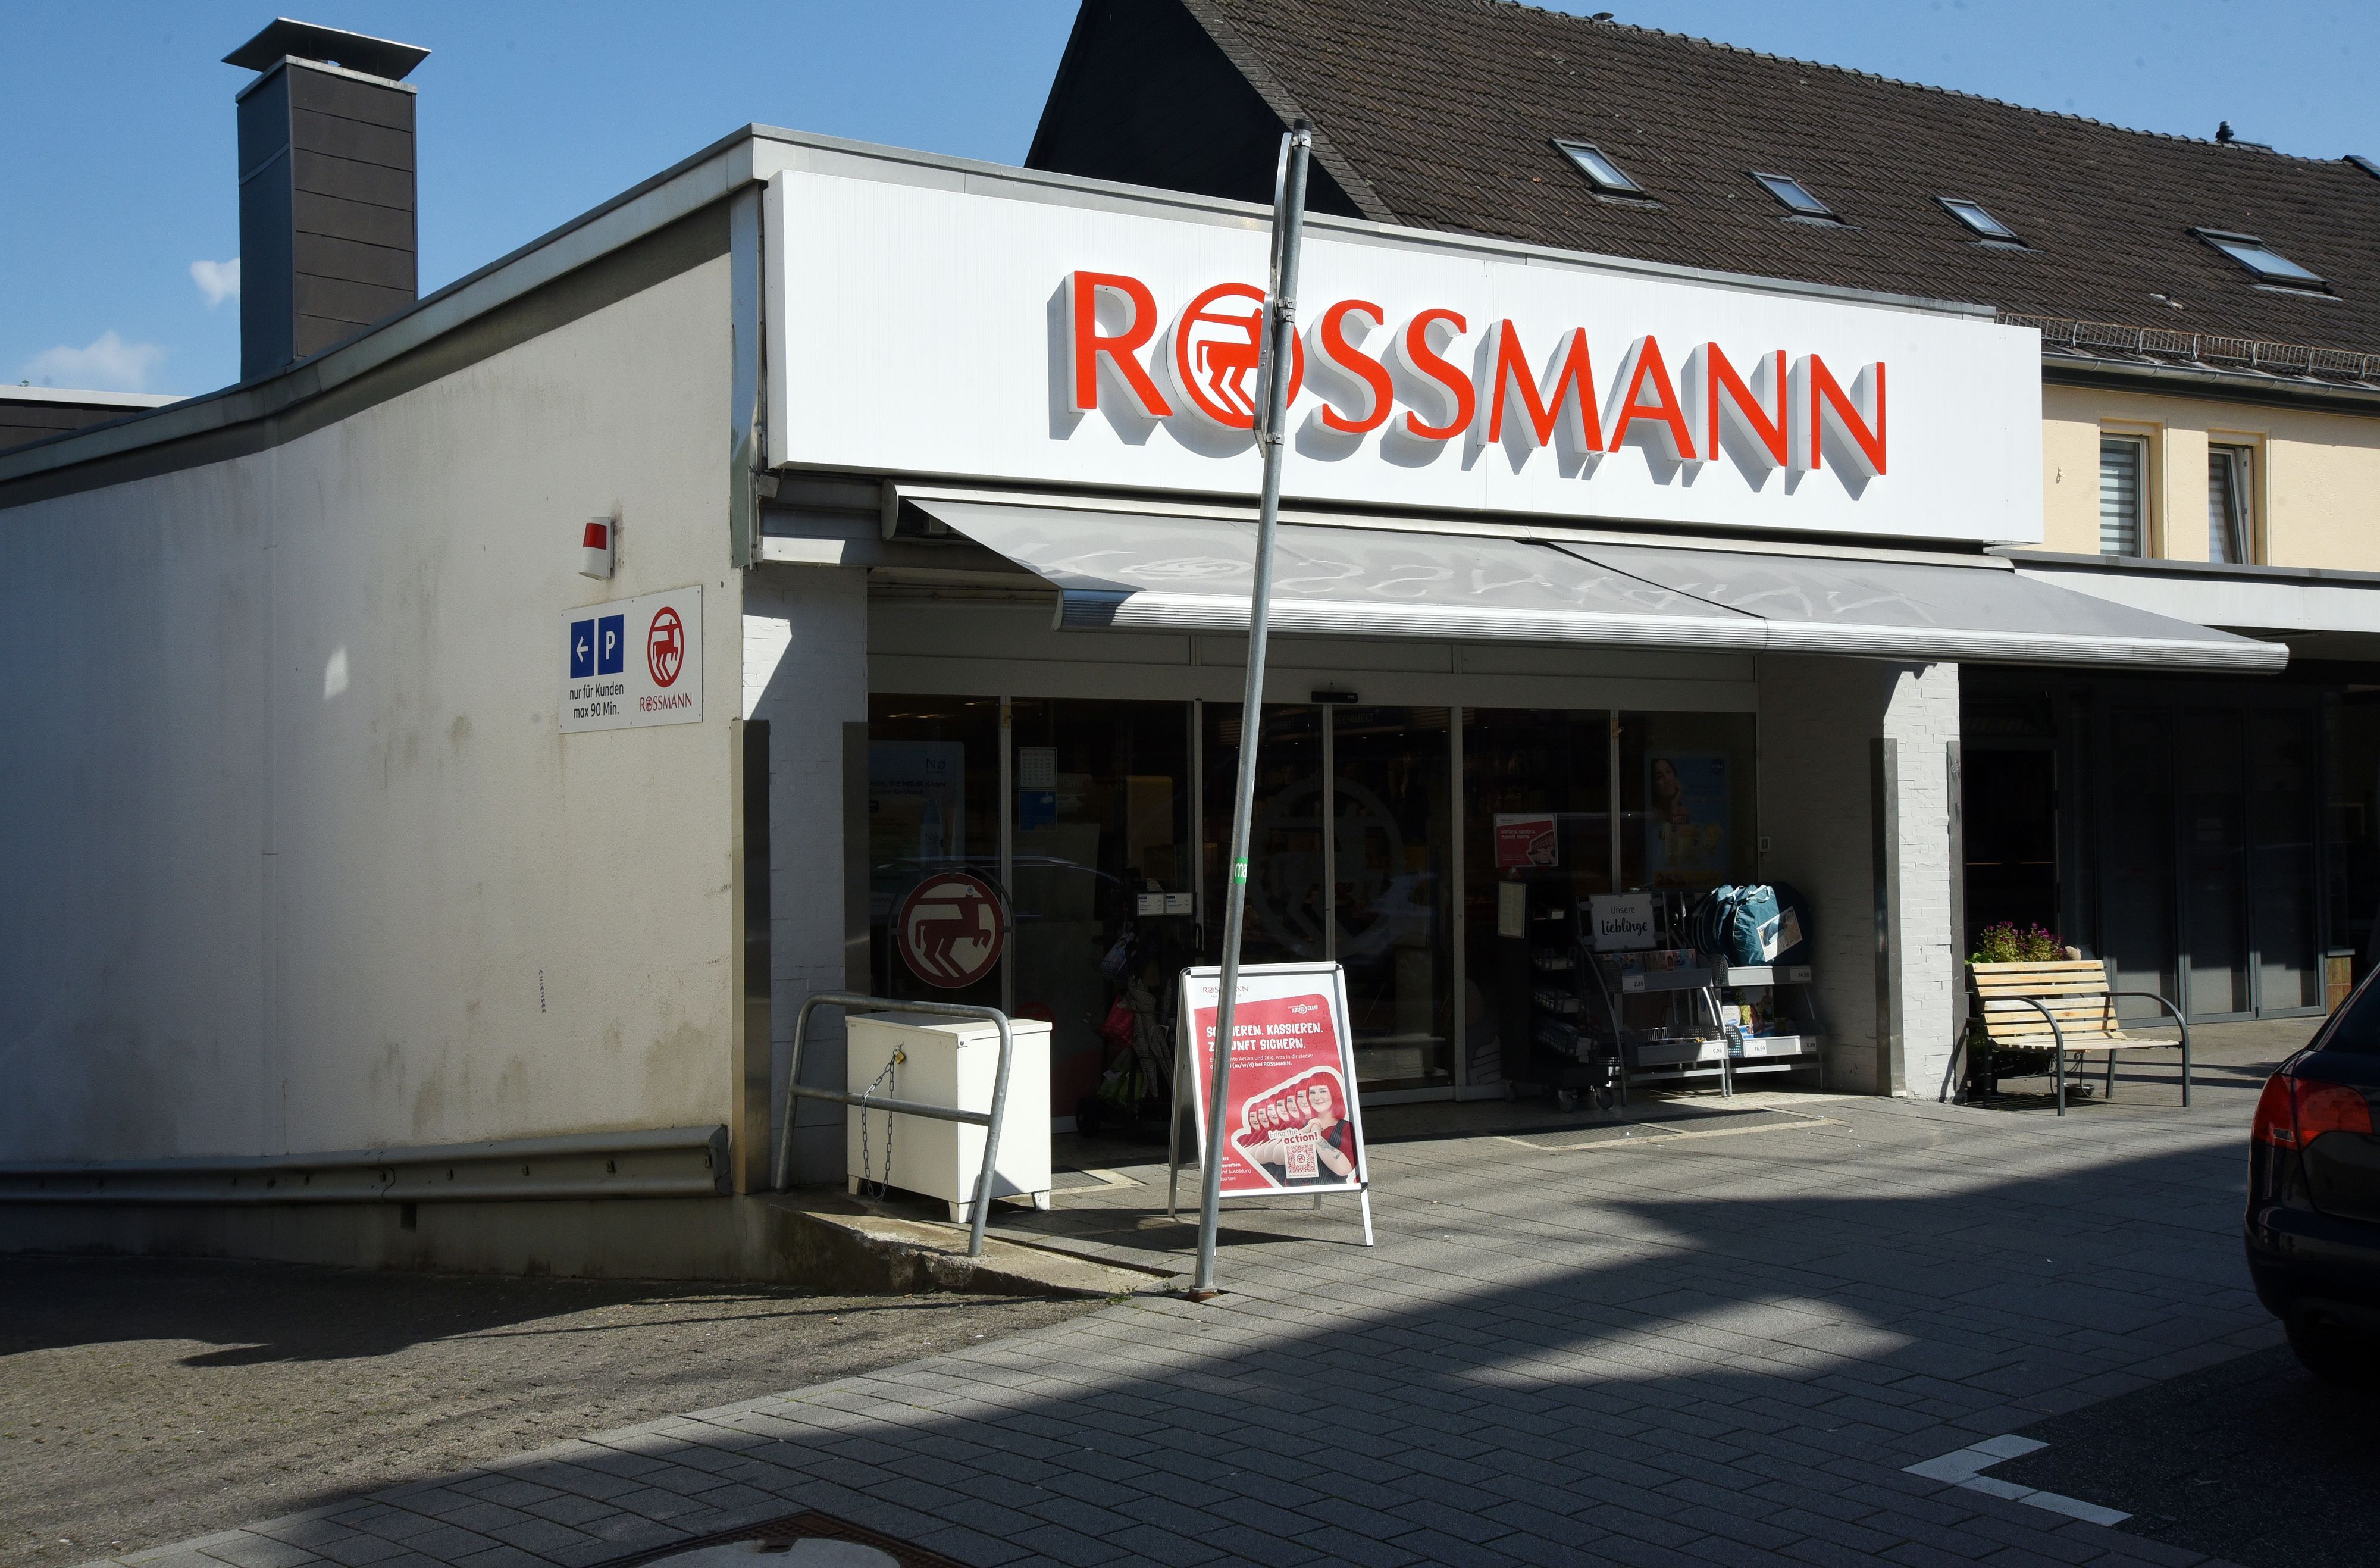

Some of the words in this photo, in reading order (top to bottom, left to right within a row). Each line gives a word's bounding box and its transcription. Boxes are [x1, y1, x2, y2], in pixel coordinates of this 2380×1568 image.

[1073, 270, 1887, 477] ROSSMANN
[606, 631, 615, 659] P
[569, 688, 582, 700] nur
[583, 684, 594, 699] für
[595, 681, 624, 697] Kunden
[574, 707, 589, 719] max
[591, 702, 601, 716] 90
[603, 701, 619, 716] Min.
[640, 692, 693, 712] ROSSMANN
[1602, 917, 1648, 936] Lieblinge
[1266, 1022, 1323, 1035] KASSIEREN.
[1207, 1039, 1257, 1052] ZUNFT
[1260, 1038, 1306, 1050] SICHERN.
[1284, 1132, 1317, 1144] action!
